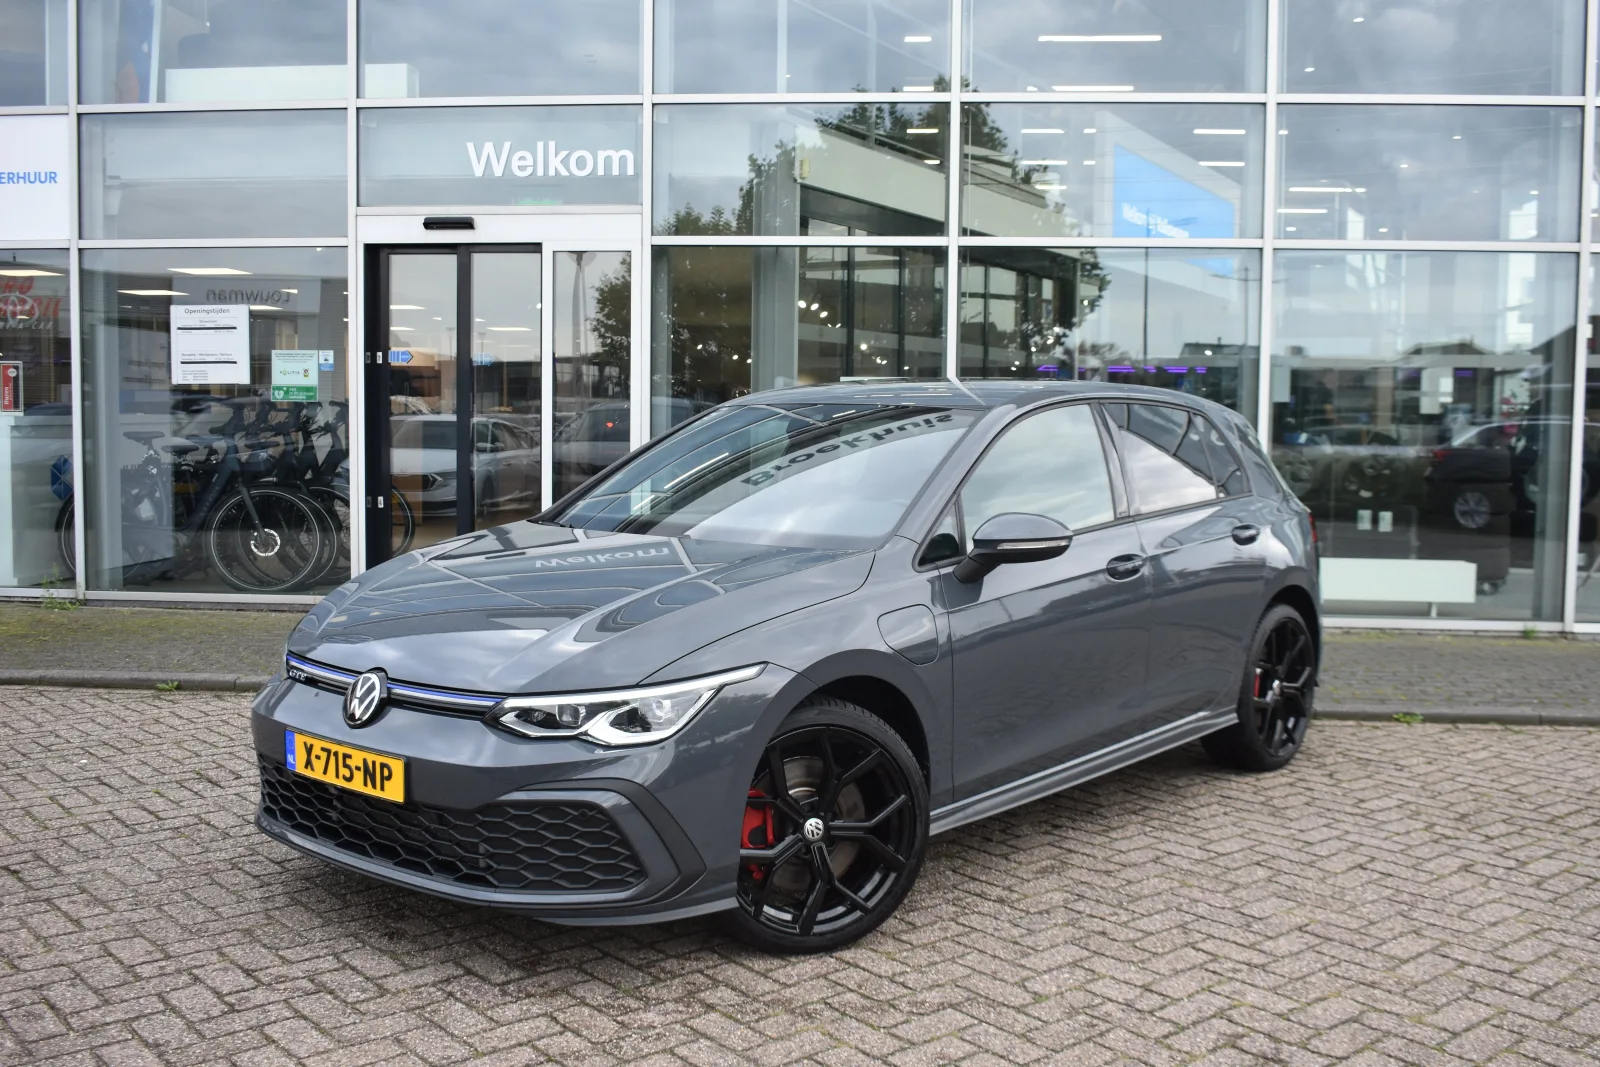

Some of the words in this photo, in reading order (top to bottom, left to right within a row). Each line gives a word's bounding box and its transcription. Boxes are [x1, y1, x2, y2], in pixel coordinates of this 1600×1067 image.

[466, 141, 635, 177] Welkom
[0, 171, 58, 184] ERHUUR
[184, 307, 230, 315] Openingstijden
[289, 668, 307, 681] GTE
[287, 754, 296, 765] NL
[303, 741, 393, 792] X-715-NP
